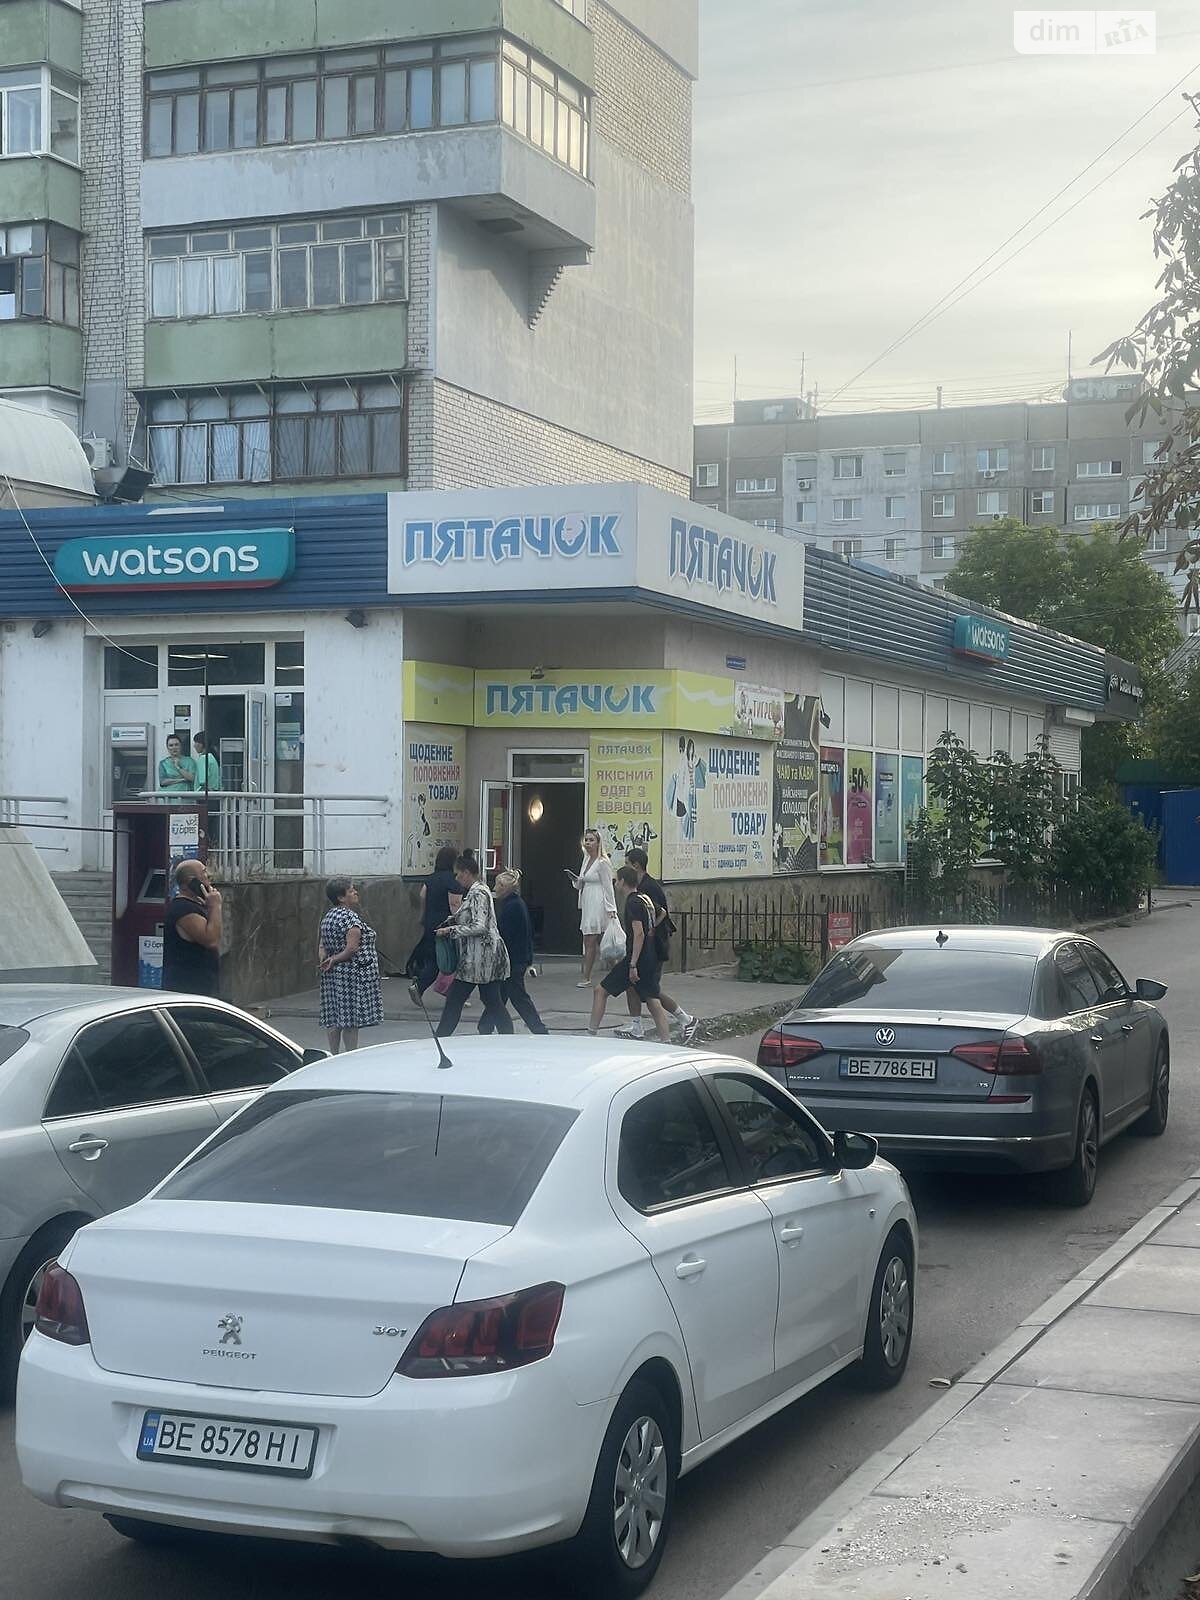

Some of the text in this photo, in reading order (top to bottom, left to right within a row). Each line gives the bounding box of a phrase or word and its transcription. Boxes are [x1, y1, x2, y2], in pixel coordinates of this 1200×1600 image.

[403, 511, 625, 567] ПЯТАЧОК
[82, 544, 259, 578] watsons
[668, 515, 777, 604] ПЯТАЧОК
[971, 623, 1006, 652] watsons
[485, 682, 657, 717] ПЯТАЧОК
[409, 743, 453, 764] ЩОДЕННЕ
[597, 744, 653, 755] ПЯТАЧОК
[413, 764, 461, 783] ПОПОВНЕННЯ
[708, 747, 760, 779] ЩОДЕННЕ
[776, 764, 790, 779] ЧАЮ
[799, 765, 814, 780] КАВИ
[596, 768, 654, 781] ЯКІСНИЙ
[428, 784, 459, 800] ТОВАРУ
[600, 785, 633, 798] ОДЯГ
[713, 778, 768, 809] ПОПОВНЕННЯ
[731, 812, 767, 836] ТОВАРУ
[849, 1056, 933, 1077] BE 7786 EH
[372, 1325, 408, 1338] 301
[202, 1349, 257, 1360] PEUGEOT
[159, 1420, 299, 1463] BE 8578 HI
